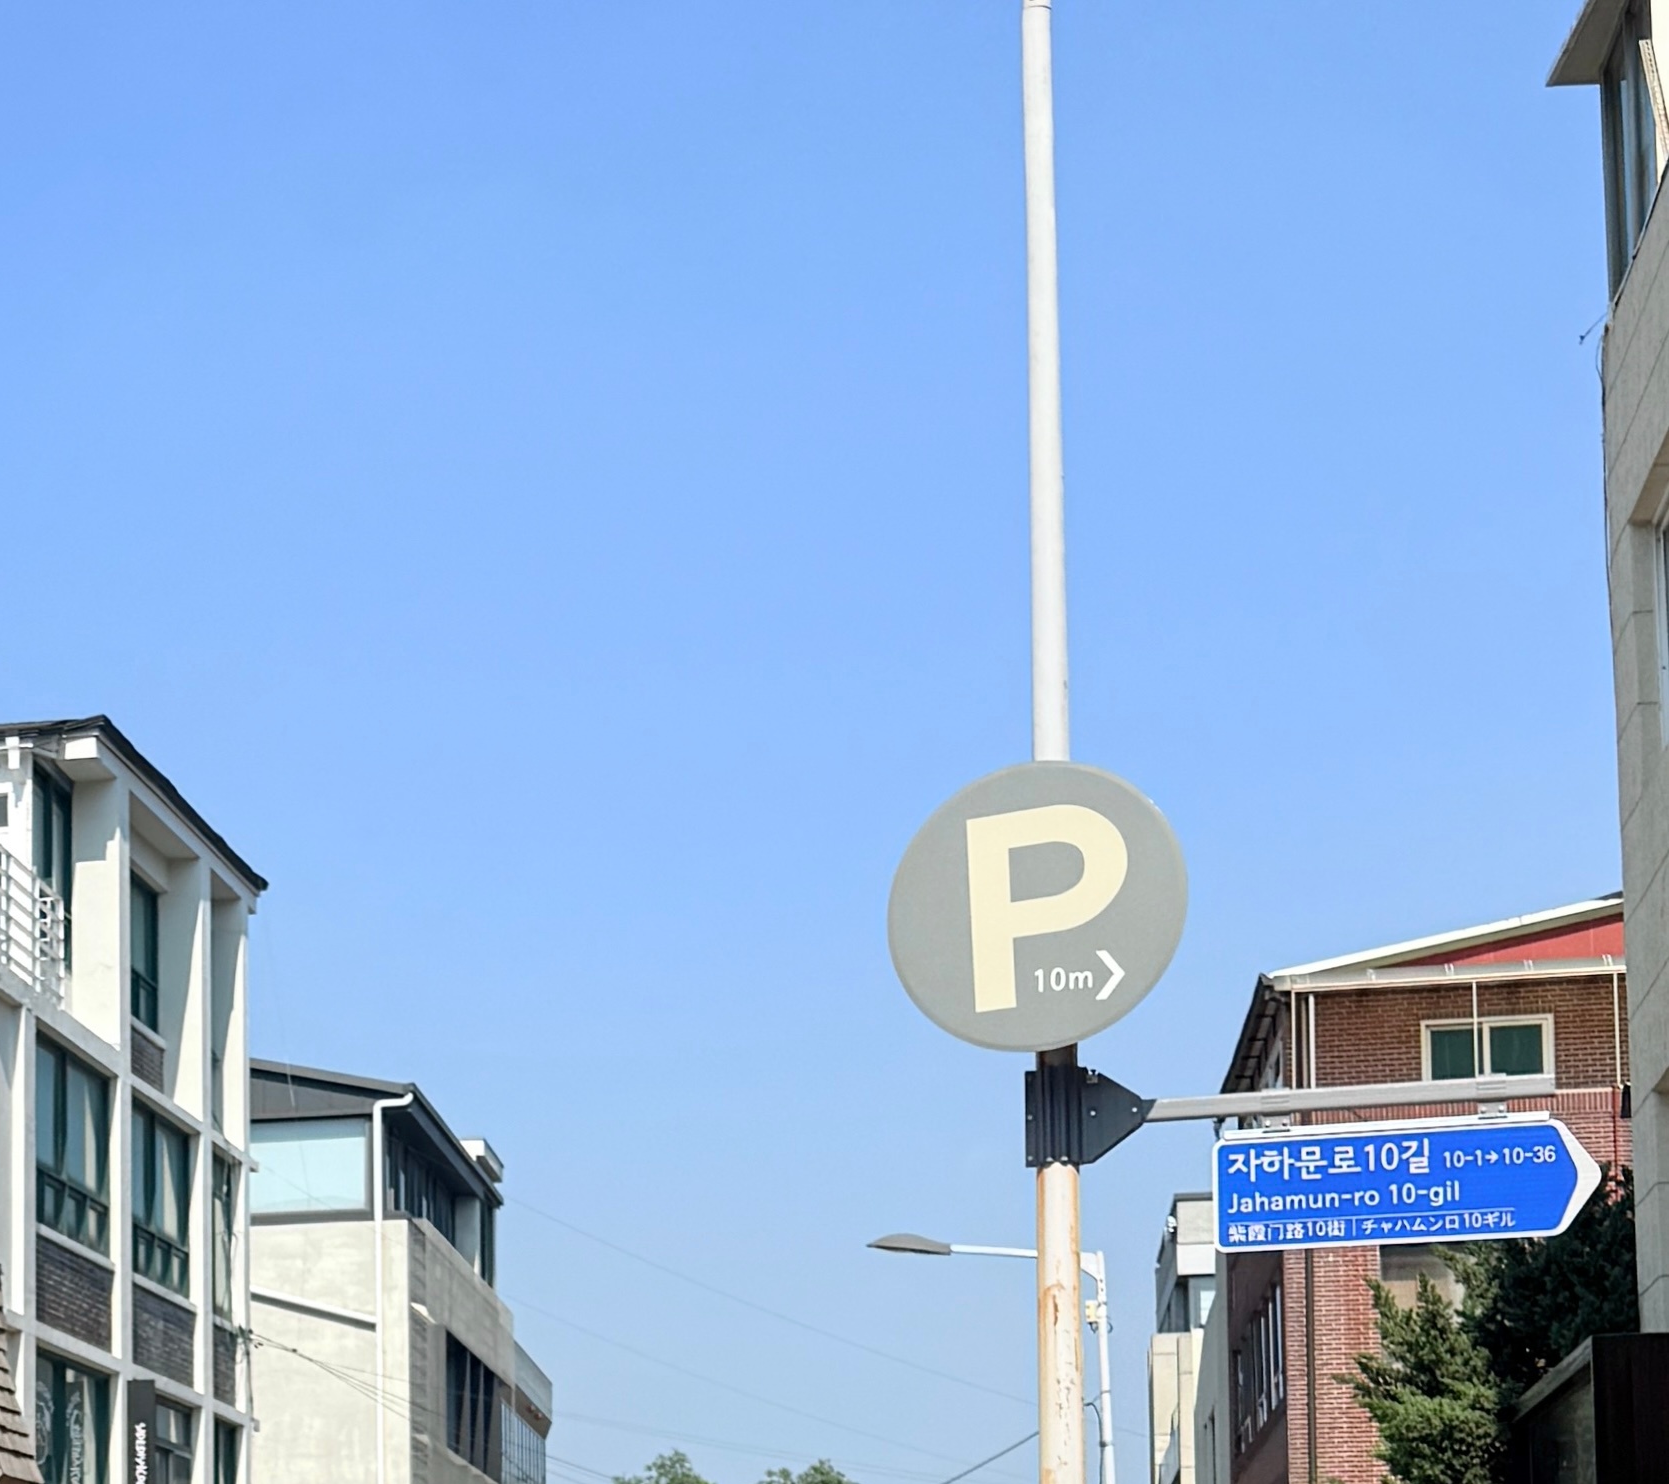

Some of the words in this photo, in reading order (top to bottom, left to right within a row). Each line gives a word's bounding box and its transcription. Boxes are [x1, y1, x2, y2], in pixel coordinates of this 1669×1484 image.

[966, 804, 1128, 1013] P
[1034, 967, 1093, 993] 10m
[1227, 1137, 1430, 1182] 자하문로10길
[1227, 1190, 1380, 1214] Jahamun-ro
[1388, 1180, 1461, 1206] 10-gil
